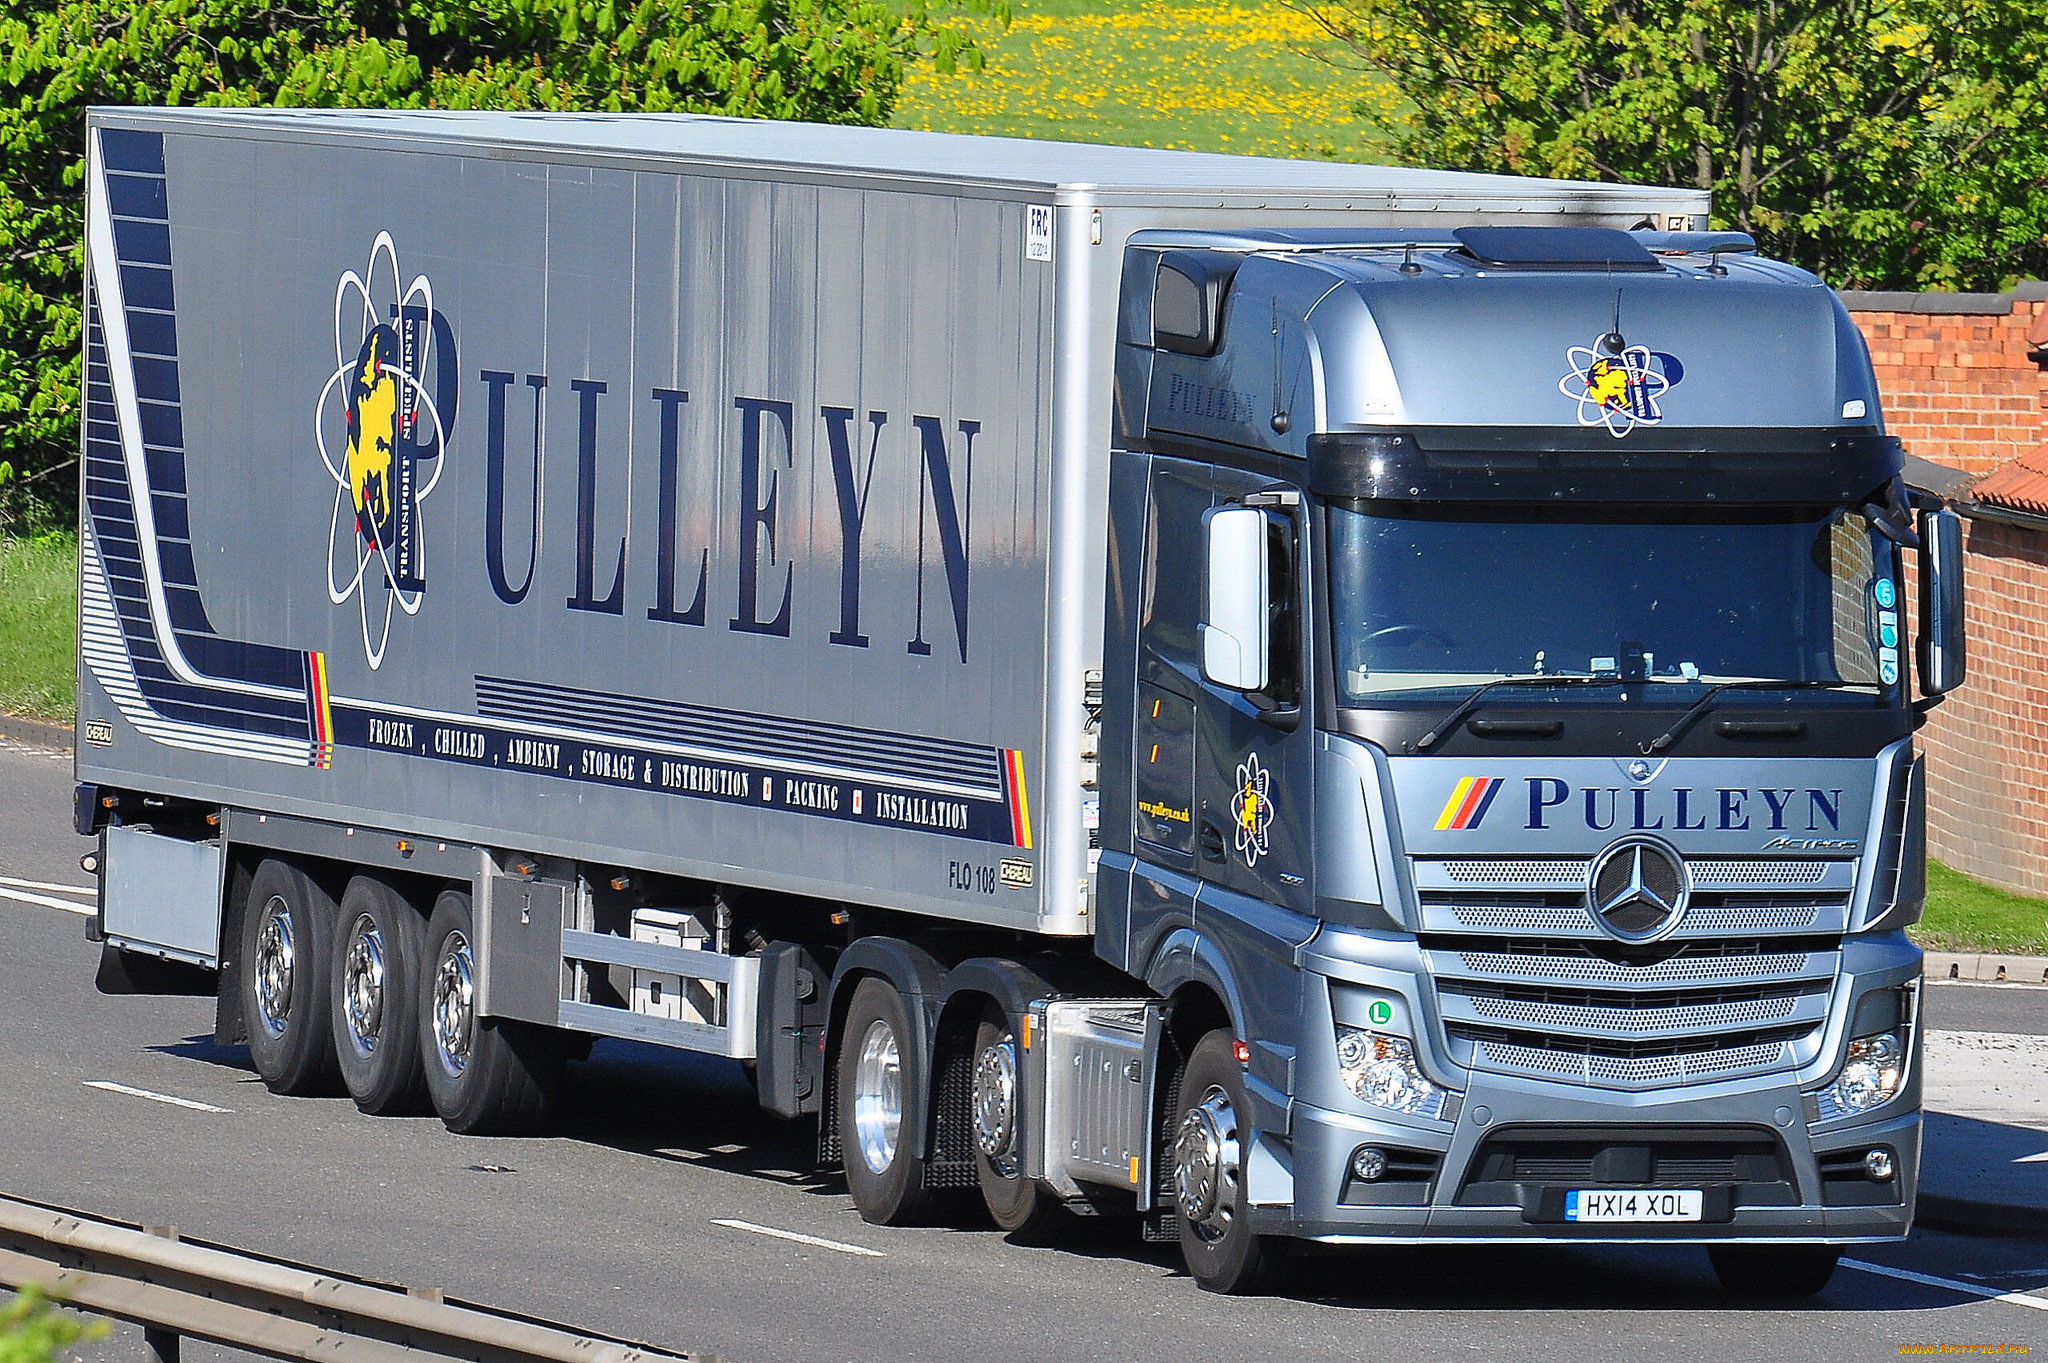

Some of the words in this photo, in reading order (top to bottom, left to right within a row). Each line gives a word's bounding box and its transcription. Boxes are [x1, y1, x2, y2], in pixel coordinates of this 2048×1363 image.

[1031, 208, 1048, 237] FRC
[383, 303, 982, 665] PULLEYN
[400, 456, 411, 578] TRANSPORT
[86, 724, 112, 742] CHEREAU
[368, 718, 414, 749] FROZEN
[434, 727, 486, 760] CHILLED
[506, 737, 561, 770] AMBIENT
[581, 749, 636, 782] STORAGE
[643, 759, 653, 784] &
[660, 760, 750, 798] DISTRIBUTION
[784, 779, 840, 812] PACKING
[875, 791, 969, 831] INSTALLATION
[1522, 776, 1843, 832] PULLEYN
[948, 861, 972, 891] FLO
[976, 865, 997, 895] 108
[1000, 863, 1034, 883] CHEREAU
[1373, 1004, 1387, 1022] L
[1586, 1194, 1638, 1217] HX14
[1646, 1194, 1690, 1217] XOL
